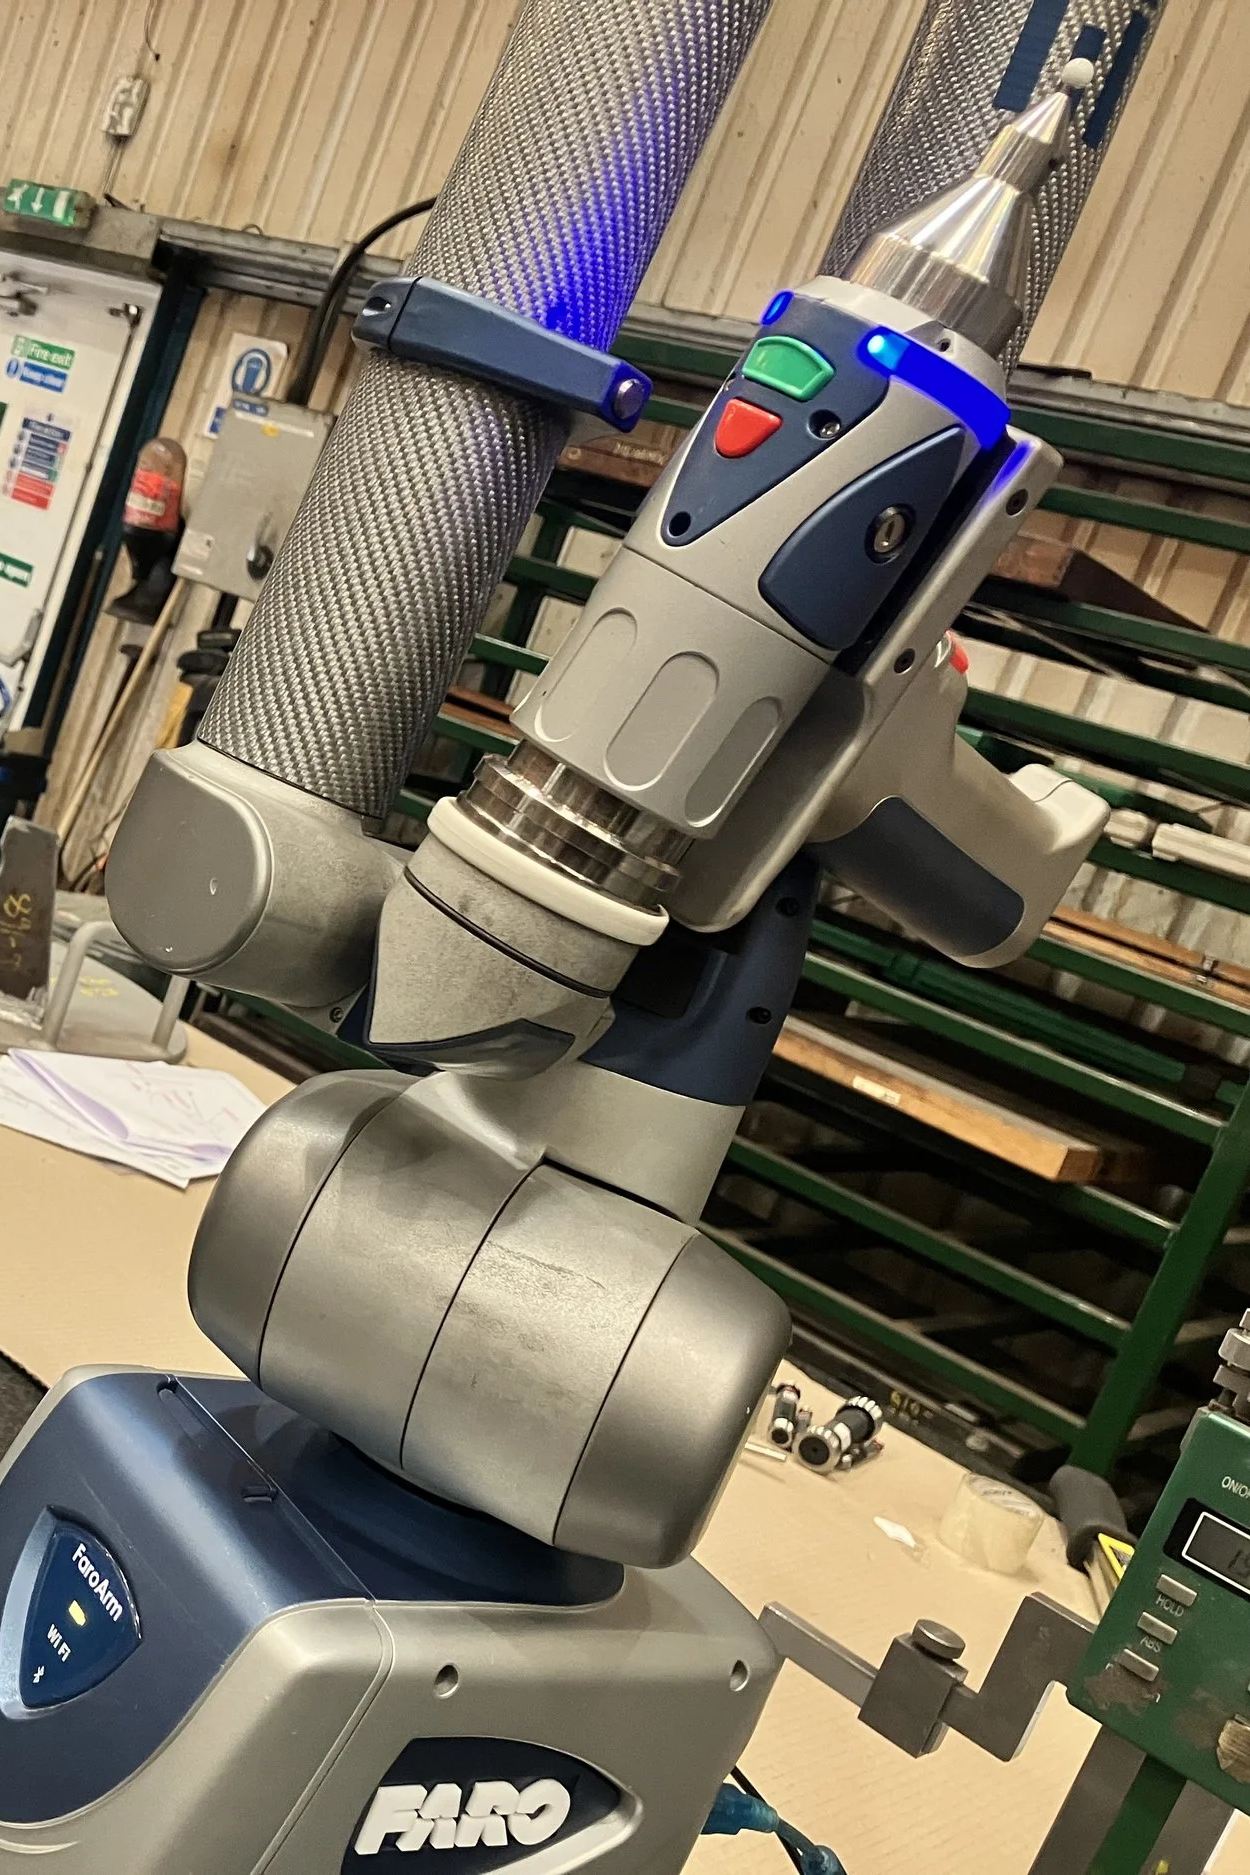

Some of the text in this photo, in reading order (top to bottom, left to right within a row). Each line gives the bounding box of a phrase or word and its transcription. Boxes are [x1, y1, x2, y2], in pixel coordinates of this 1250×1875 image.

[72, 1542, 123, 1622] FaroArm
[1155, 1594, 1184, 1618] HOLD
[1140, 1635, 1161, 1653] ABS
[354, 1778, 571, 1855] FARO
